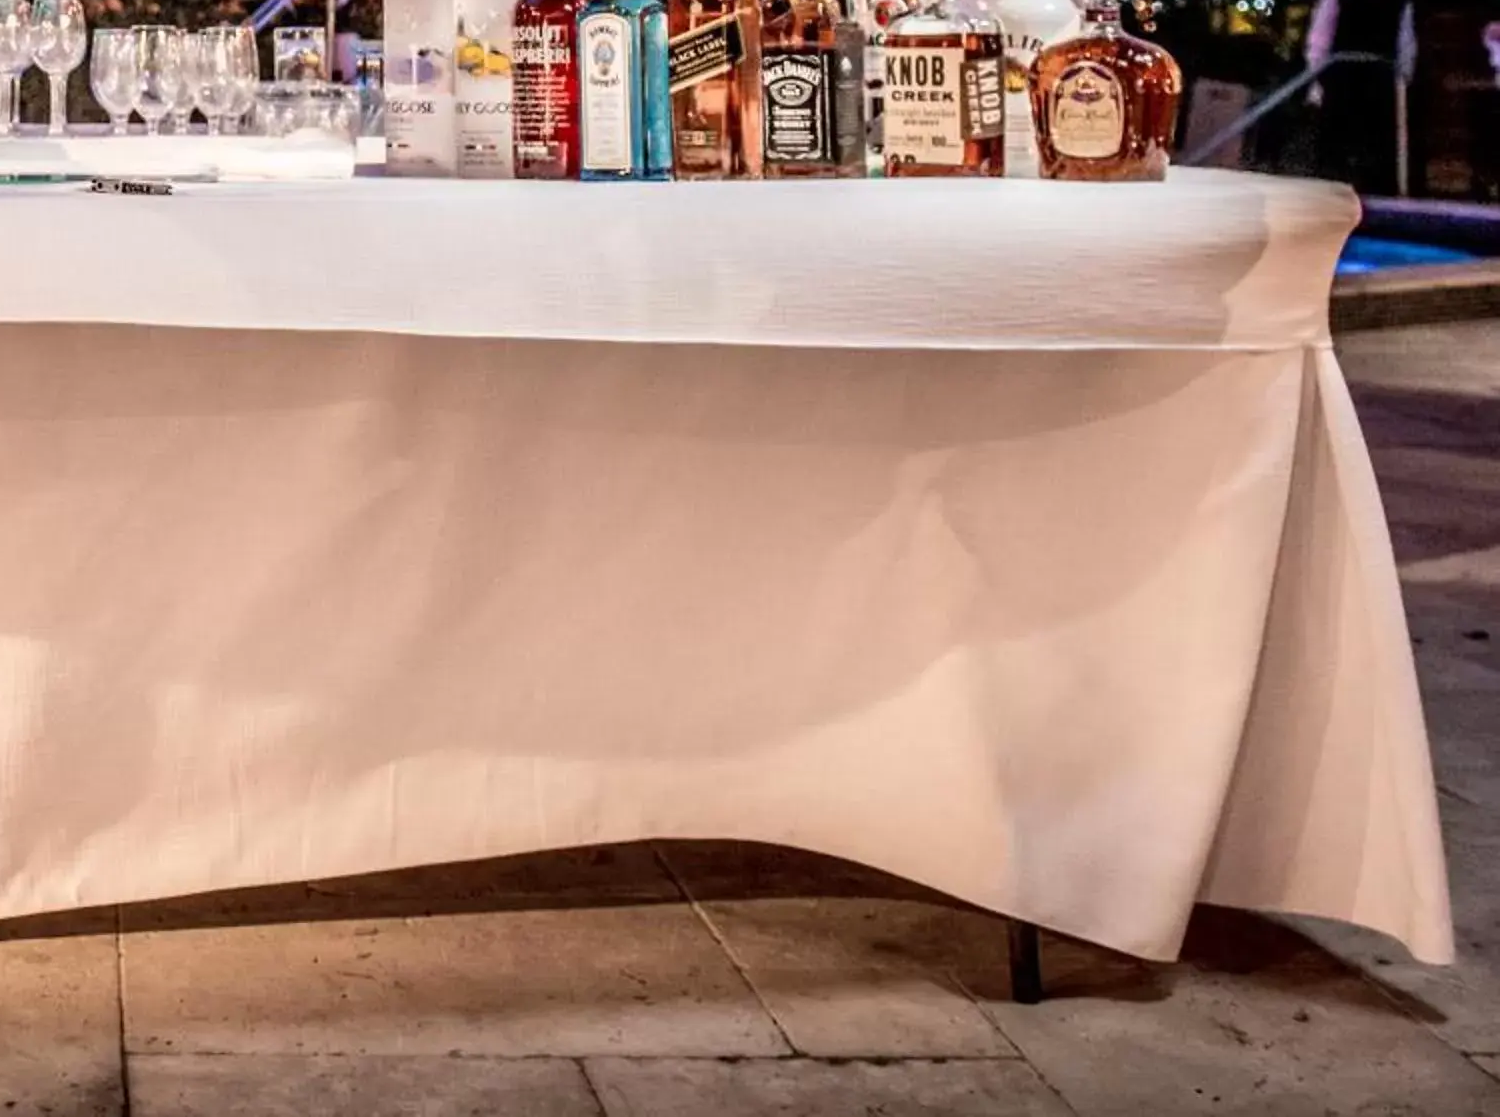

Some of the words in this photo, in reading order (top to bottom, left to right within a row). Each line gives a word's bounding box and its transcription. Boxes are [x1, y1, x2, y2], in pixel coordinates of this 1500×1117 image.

[697, 37, 727, 55] LABEL
[885, 55, 945, 86] KNOB
[891, 90, 954, 102] CREEK
[965, 69, 982, 136] CREEK
[977, 60, 1001, 125] KNOB
